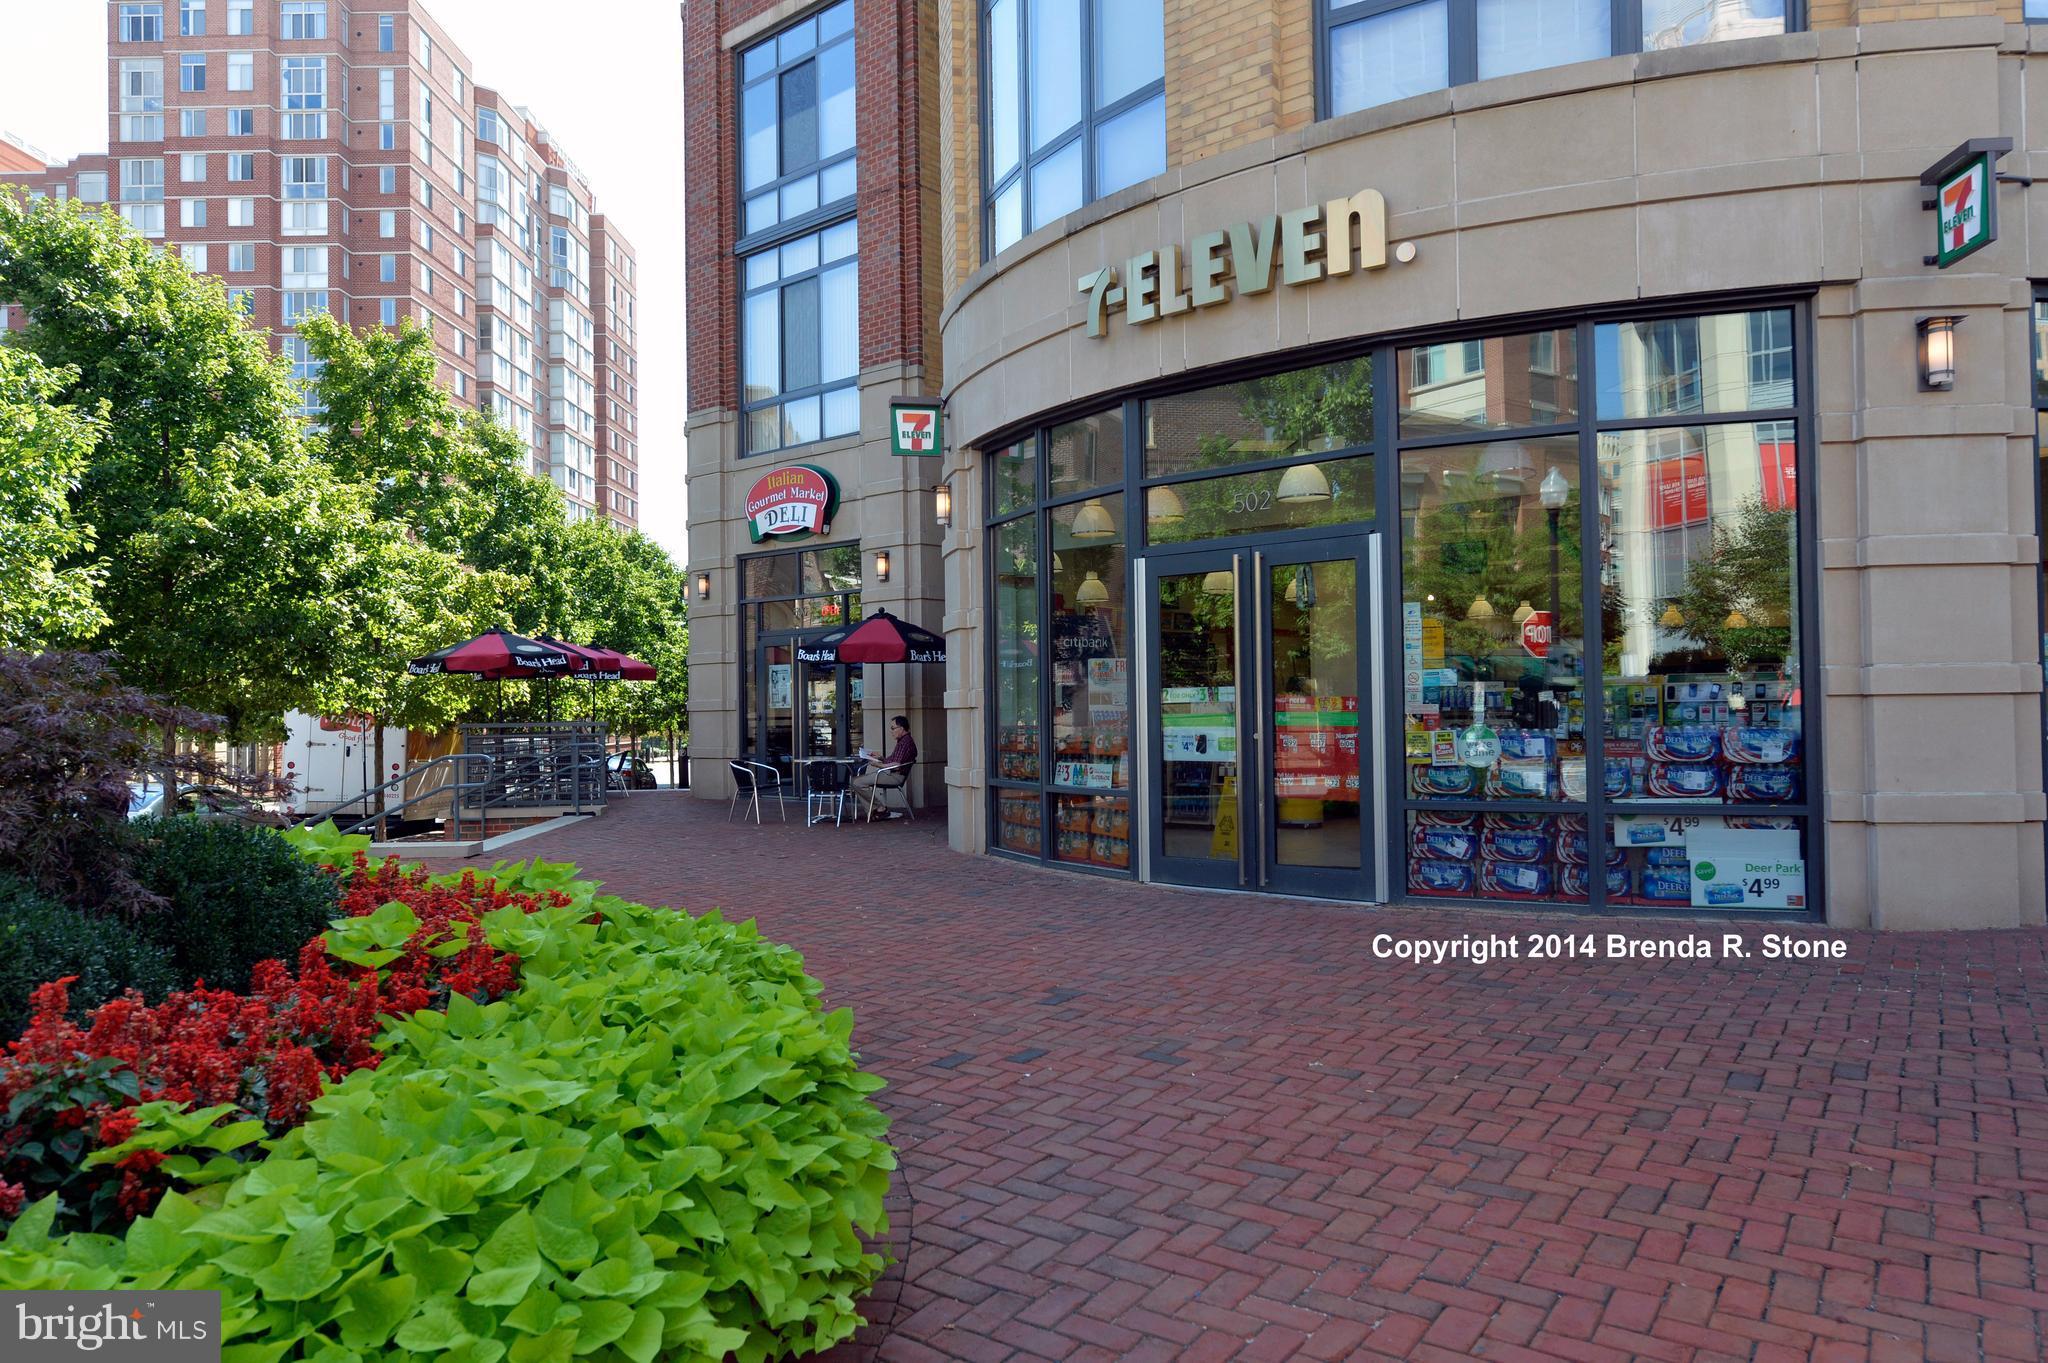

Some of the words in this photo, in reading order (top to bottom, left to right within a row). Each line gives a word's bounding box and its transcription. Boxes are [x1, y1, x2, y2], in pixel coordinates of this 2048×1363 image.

[767, 471, 805, 490] Italian
[748, 488, 787, 513] Gourmet
[790, 486, 824, 502] Market
[1233, 490, 1271, 513] 502
[764, 505, 808, 526] DELI
[1063, 637, 1108, 648] citibank
[541, 654, 567, 666] Head
[599, 670, 620, 680] Head
[1745, 863, 1771, 873] Deer
[1776, 863, 1801, 873] Park
